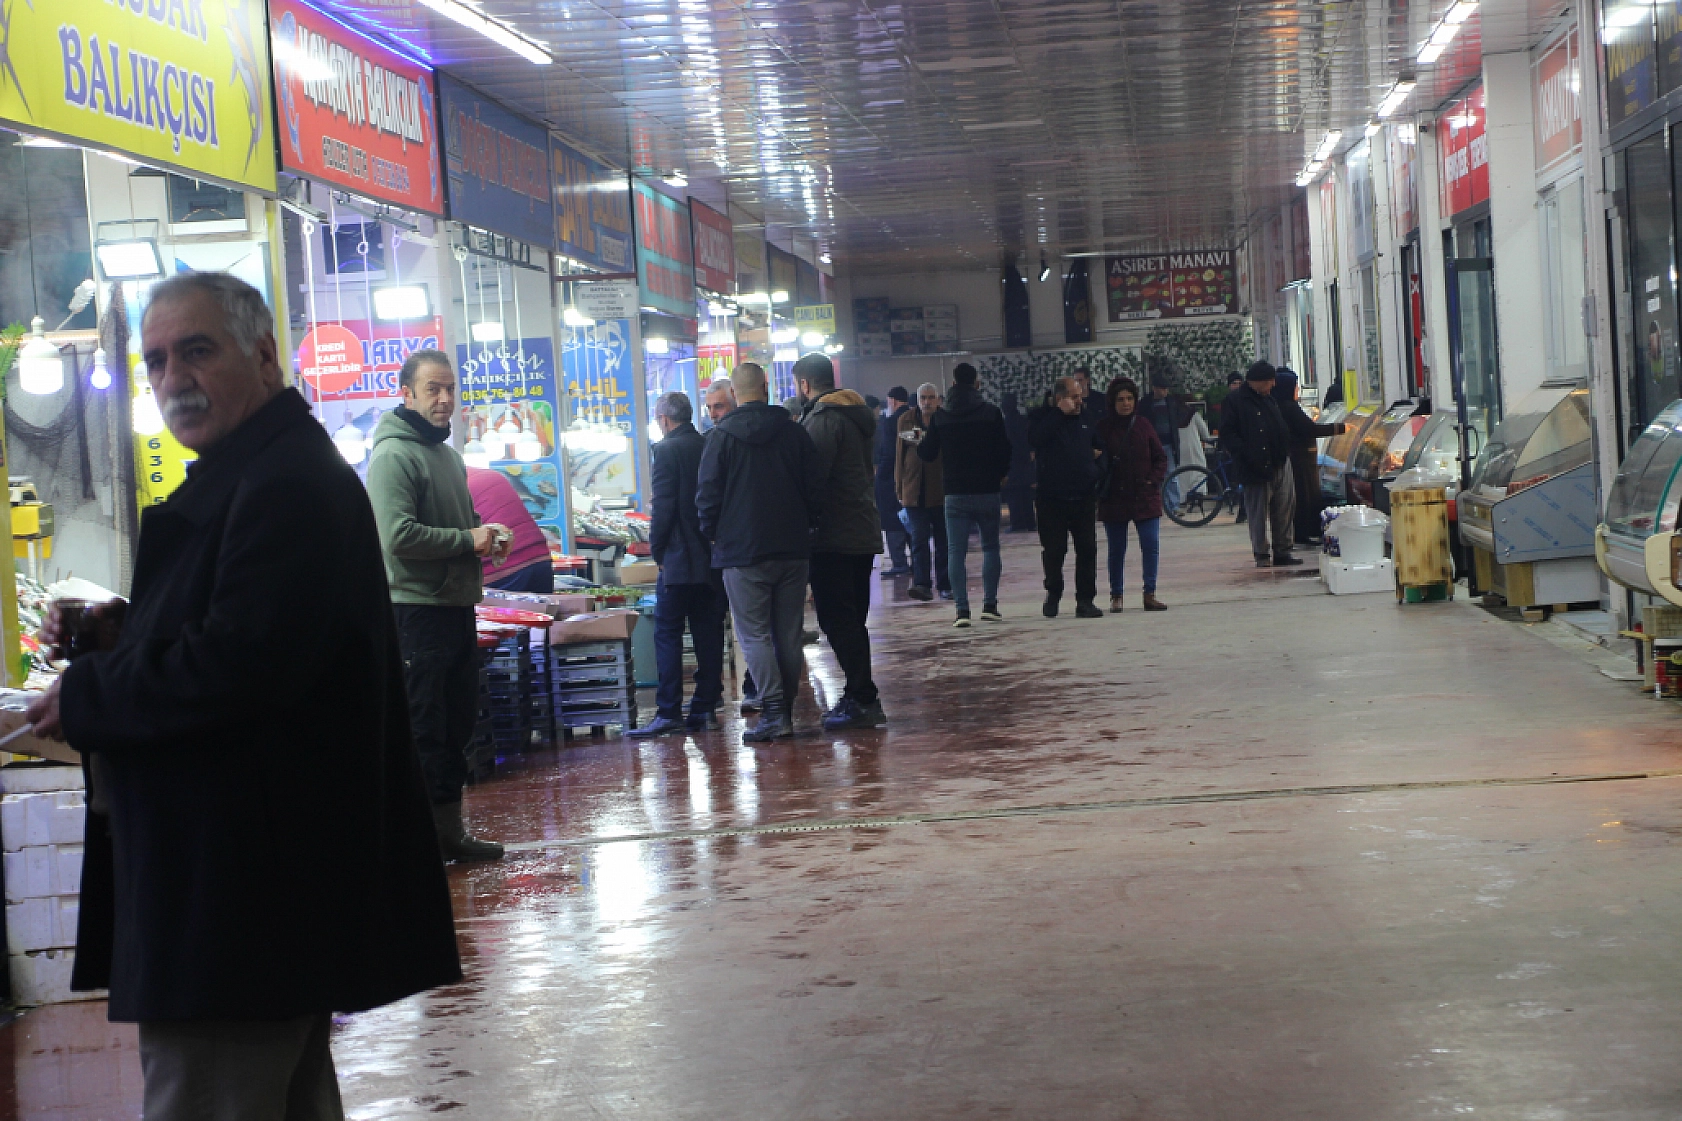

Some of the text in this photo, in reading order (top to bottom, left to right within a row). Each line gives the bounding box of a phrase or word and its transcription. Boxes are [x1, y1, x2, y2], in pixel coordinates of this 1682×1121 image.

[59, 25, 218, 153] BALIKÇISI
[1169, 251, 1230, 269] MANAVI
[303, 362, 362, 377] GEÇERLİDİR
